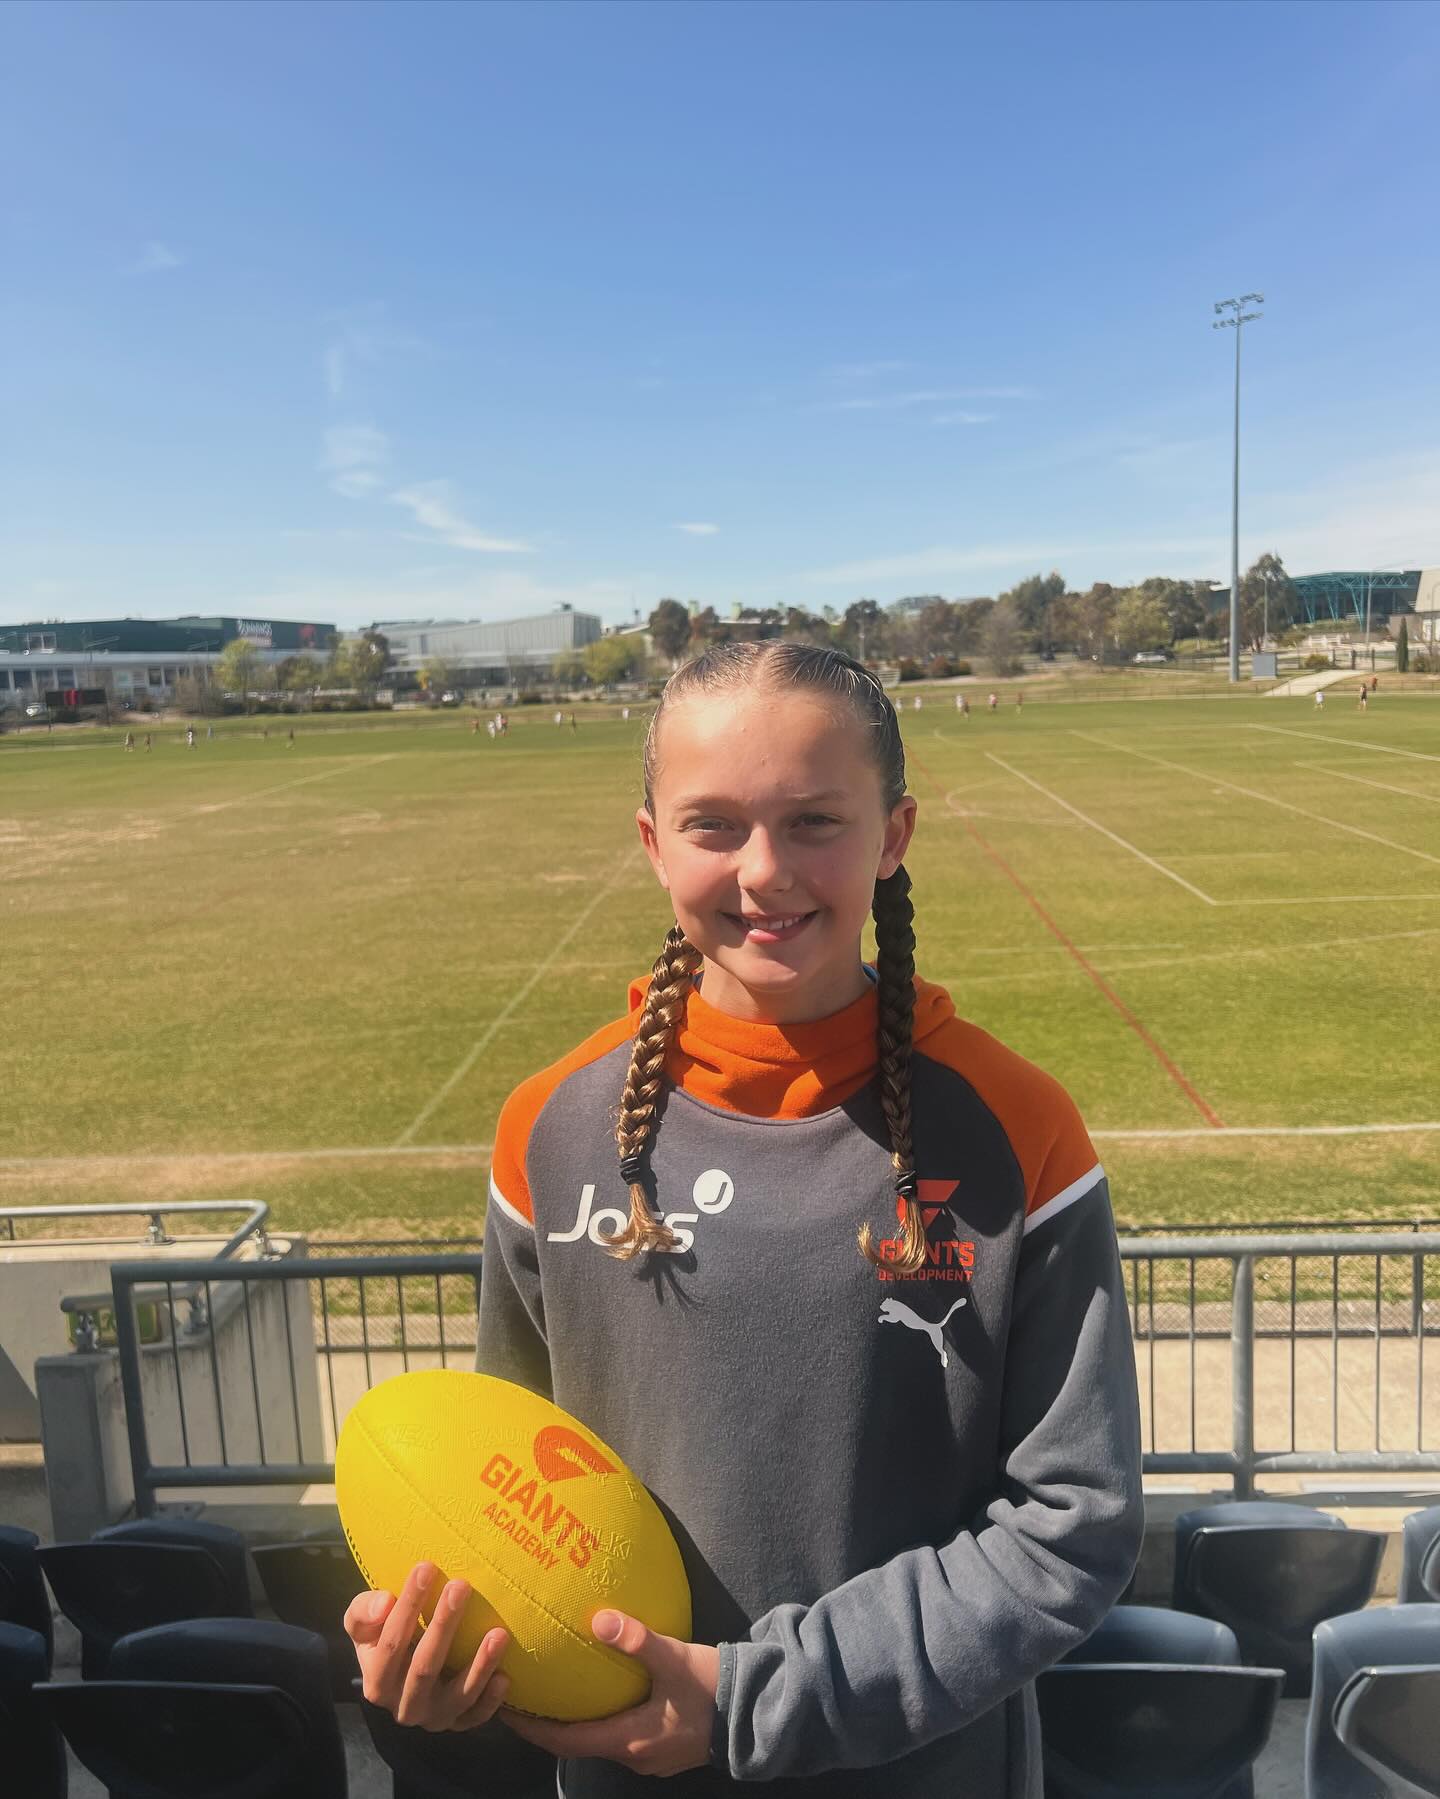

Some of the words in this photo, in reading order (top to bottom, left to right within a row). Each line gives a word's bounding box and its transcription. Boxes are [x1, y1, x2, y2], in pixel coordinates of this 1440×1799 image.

[546, 1184, 699, 1254] Jos
[880, 1239, 975, 1267] GINTS
[878, 1268, 973, 1281] DEVELOPMENT
[479, 1453, 600, 1569] GIANTS
[482, 1501, 561, 1571] ACADEMY
